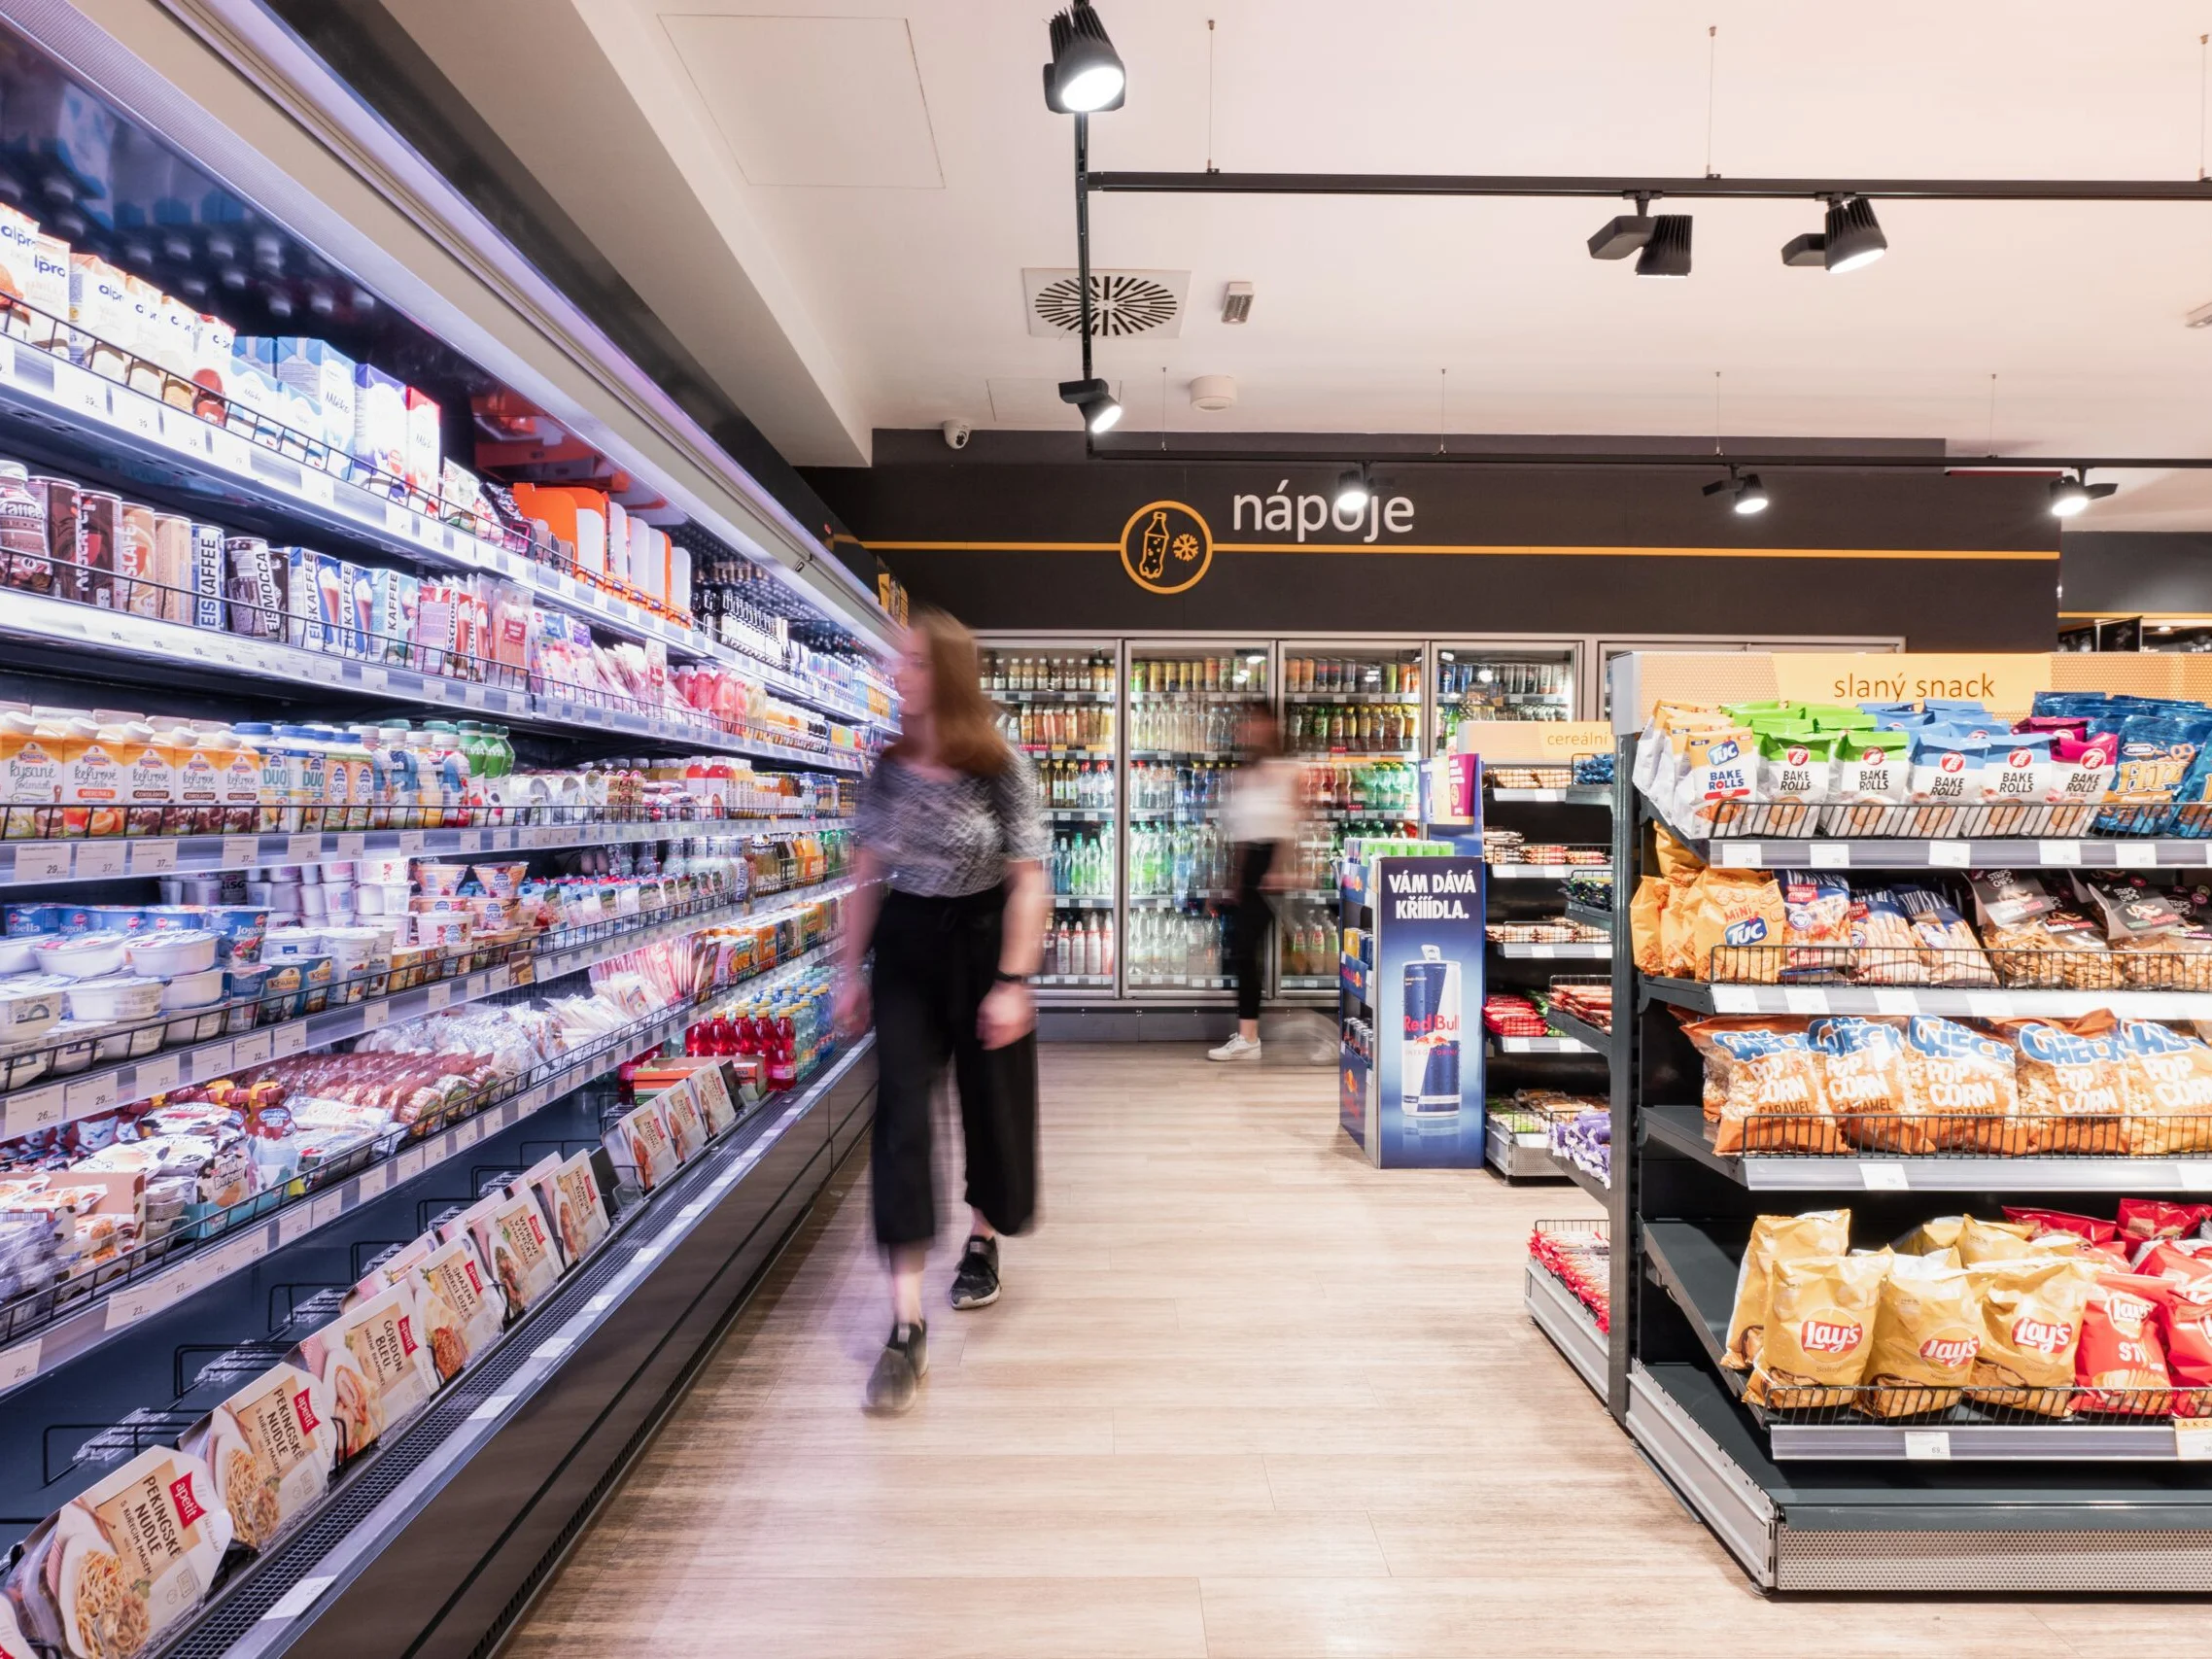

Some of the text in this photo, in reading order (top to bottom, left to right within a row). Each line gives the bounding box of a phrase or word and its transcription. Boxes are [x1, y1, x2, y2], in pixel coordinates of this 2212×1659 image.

[1, 225, 36, 247] alpr
[1233, 479, 1414, 542] nápoje
[1834, 673, 1995, 703] slaný snack
[1711, 743, 1738, 764] TUC
[262, 769, 288, 785] DUO
[302, 771, 325, 786] DUO
[1709, 778, 1745, 790] ROLLS
[1710, 770, 1742, 780] BAKE
[1780, 781, 1811, 791] ROLLS
[1782, 771, 1810, 780] BAKE
[1859, 780, 1889, 790] ROLLS
[1860, 770, 1888, 780] BAKE
[1934, 777, 1964, 787] BAKE
[2002, 773, 2033, 782] BAKE
[2071, 773, 2101, 783] BAKE
[1930, 787, 1963, 796] ROLLS
[1999, 782, 2034, 792] ROLLS
[2066, 782, 2098, 792] ROLLS
[1388, 869, 1476, 893] VÁM DÁVÁ
[1396, 895, 1469, 919] KŘÍÍÍDLA.
[1728, 922, 1764, 945] TUC
[1403, 1015, 1432, 1032] Red
[1748, 1057, 1783, 1084] POP
[1826, 1056, 1863, 1079] POP
[2055, 1068, 2094, 1090] POP
[2141, 1056, 2194, 1082] POP
[1828, 1074, 1891, 1101] CORN
[1929, 1081, 1997, 1107] CORN
[2058, 1087, 2120, 1114] CORN
[399, 1320, 413, 1351] apetit
[1804, 1321, 1860, 1353] Lay's
[2014, 1317, 2071, 1353] Lay's
[1922, 1336, 1979, 1367] Lay's
[296, 1396, 314, 1428] apetit
[266, 1414, 289, 1457] NUDLE
[175, 1481, 197, 1521] apetit
[142, 1474, 184, 1560] PEKINGSKÉ
[134, 1504, 163, 1555] NUDLE
